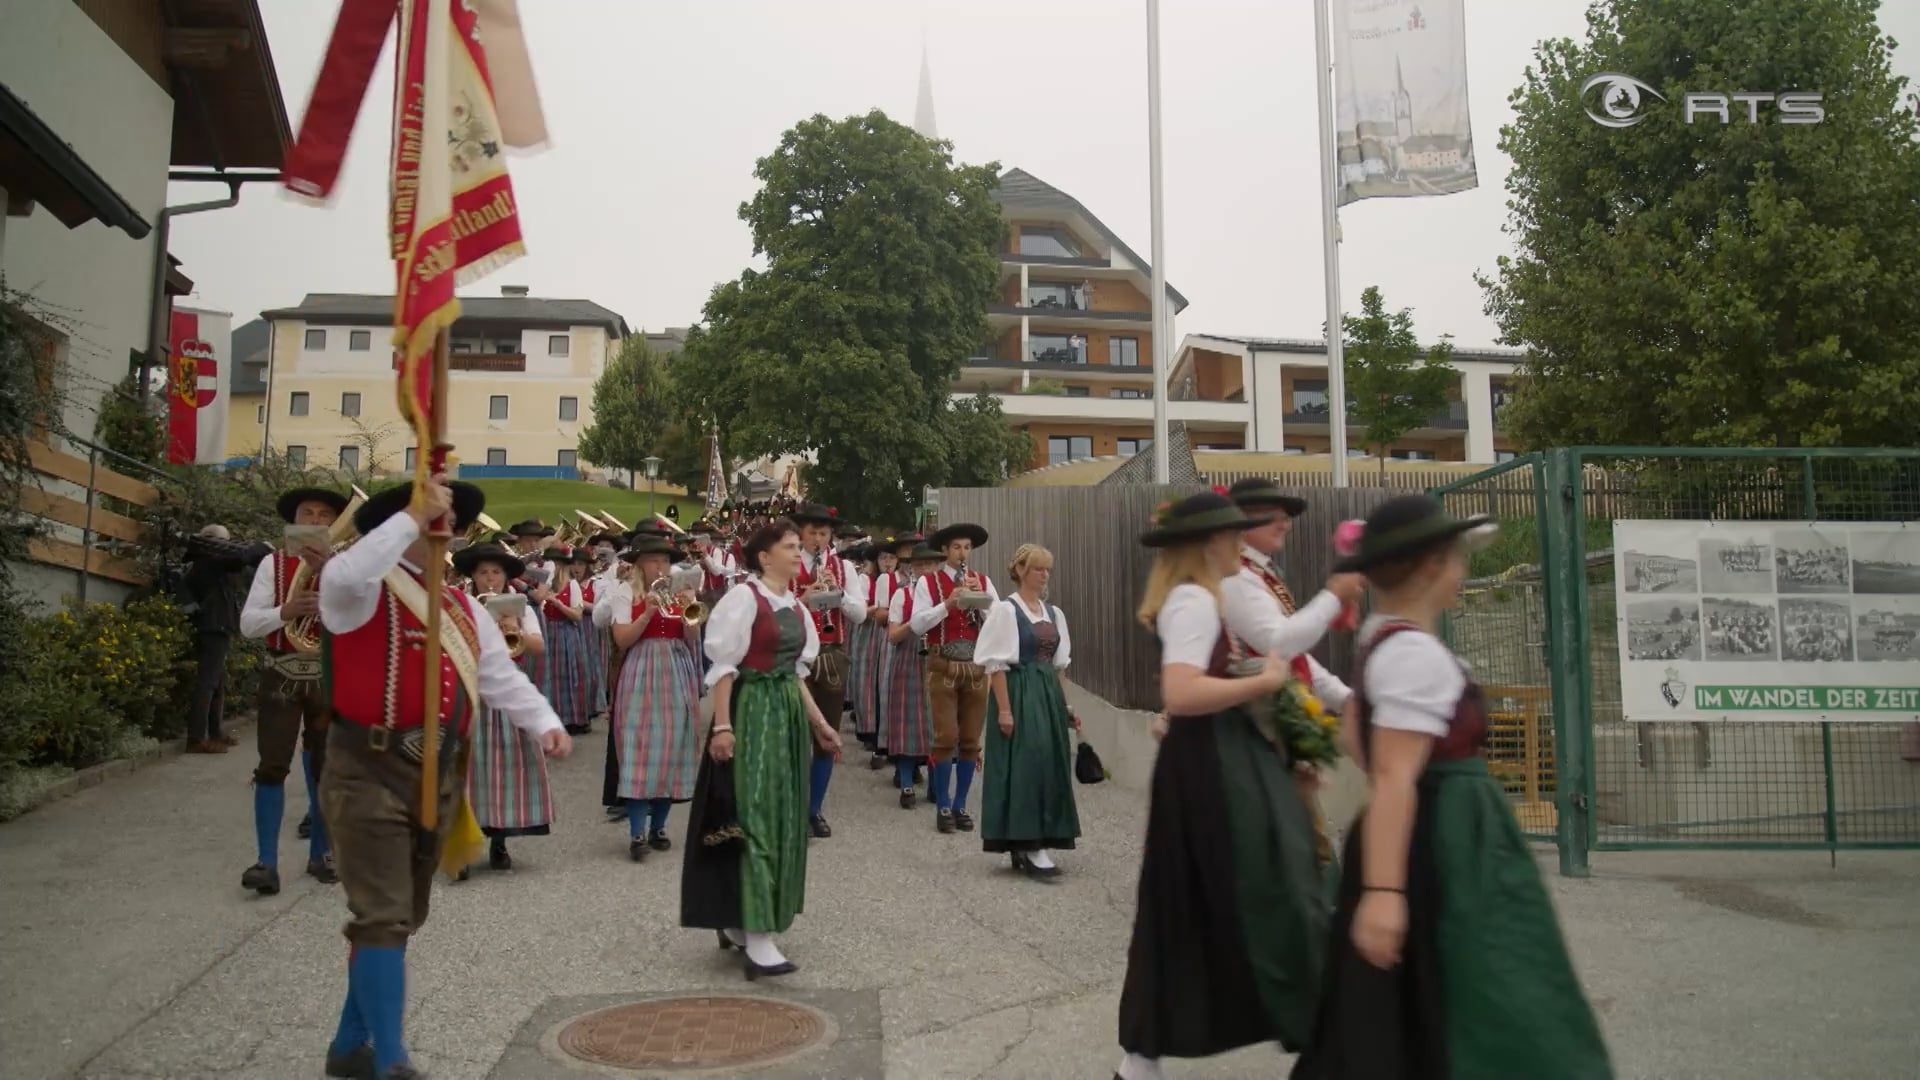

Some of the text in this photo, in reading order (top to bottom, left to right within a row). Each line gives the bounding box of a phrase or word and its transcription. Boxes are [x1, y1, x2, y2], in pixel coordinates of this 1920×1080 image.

[1698, 689, 1919, 708] IM WANDEL DER ZEIT
